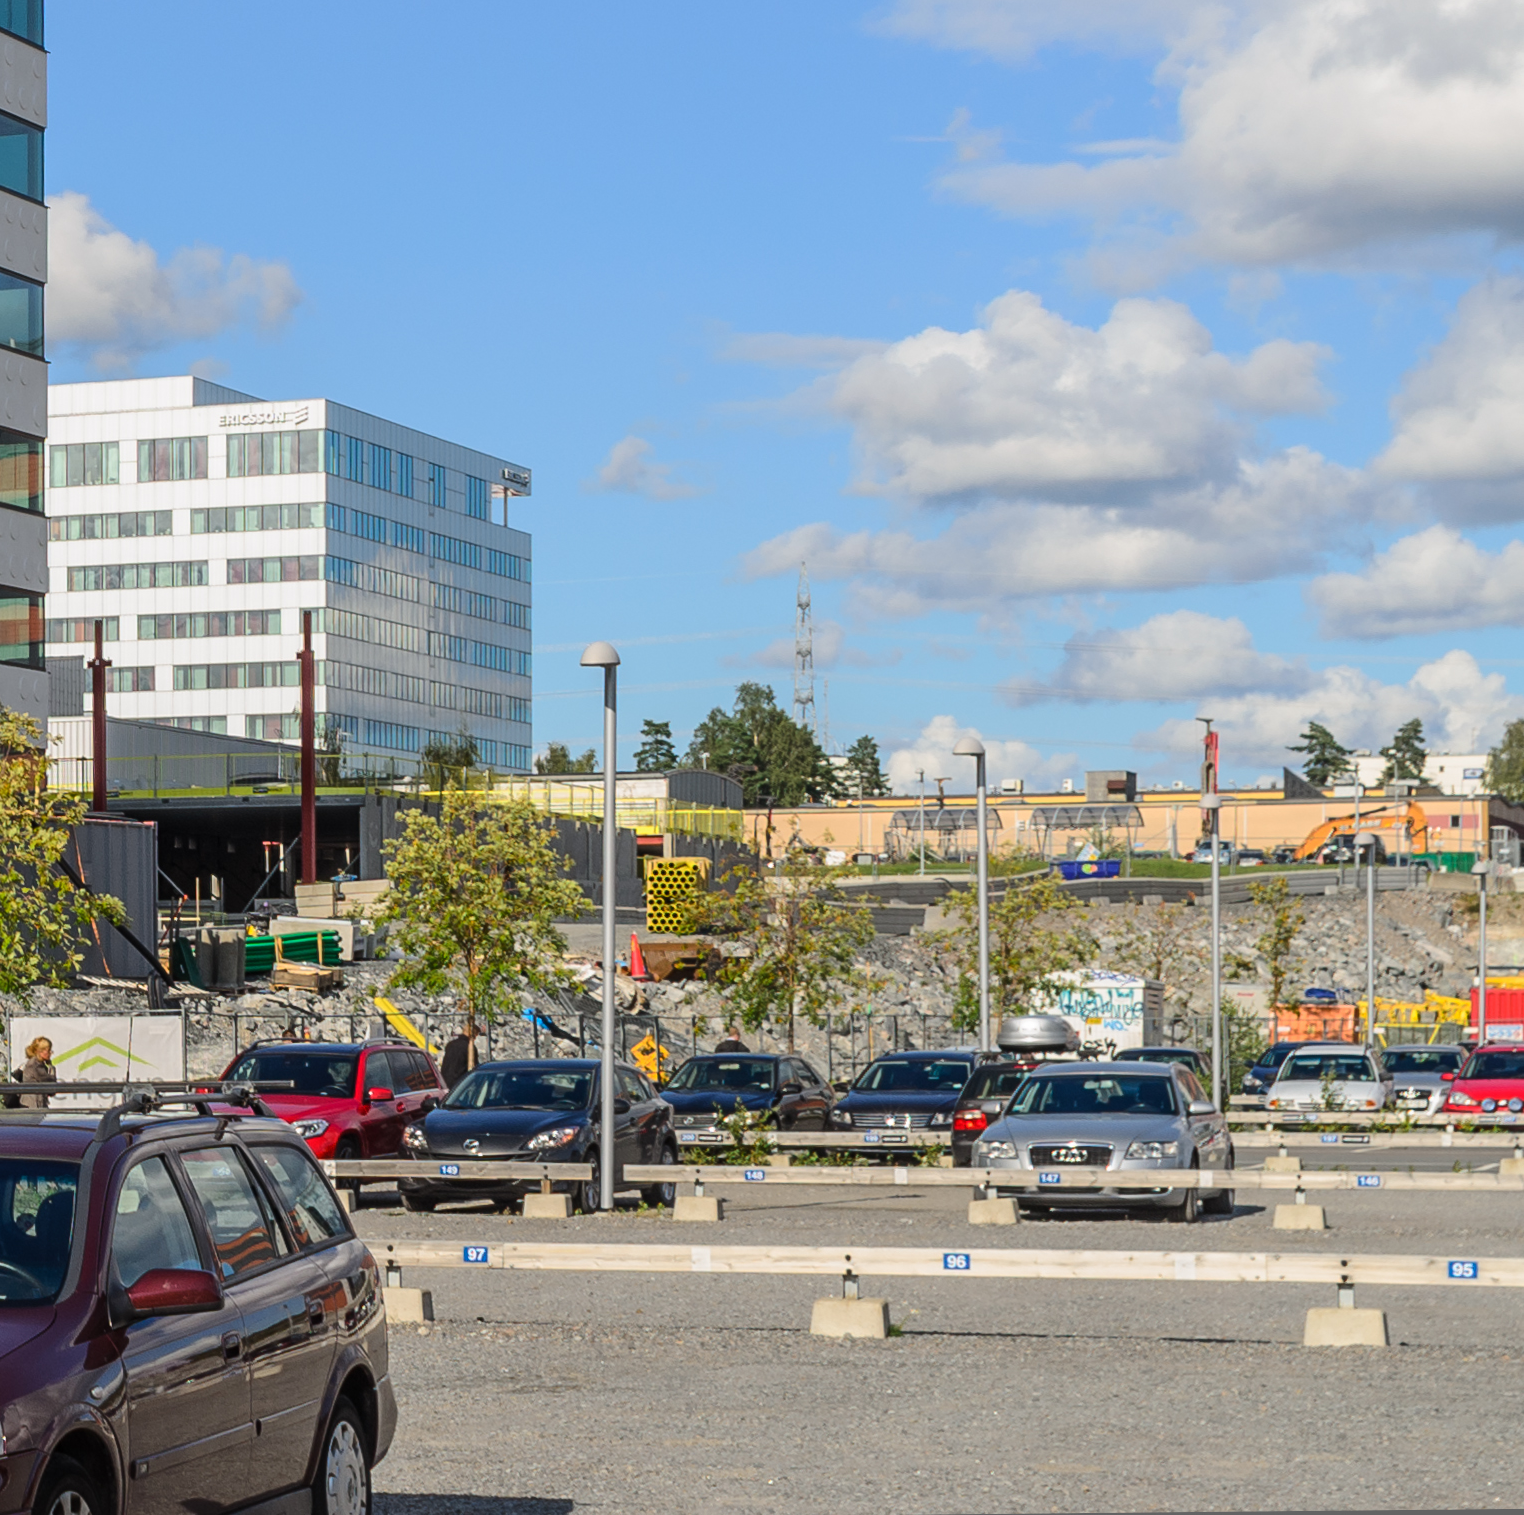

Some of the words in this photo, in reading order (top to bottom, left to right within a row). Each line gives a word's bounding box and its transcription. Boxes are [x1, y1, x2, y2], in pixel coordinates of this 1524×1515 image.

[218, 412, 286, 427] ERICSSON
[441, 1166, 458, 1175] 149
[746, 1170, 764, 1180] 148
[1041, 1173, 1058, 1182] 147
[467, 1248, 486, 1261] 97
[947, 1255, 966, 1268] 96
[1452, 1262, 1474, 1277] 95
